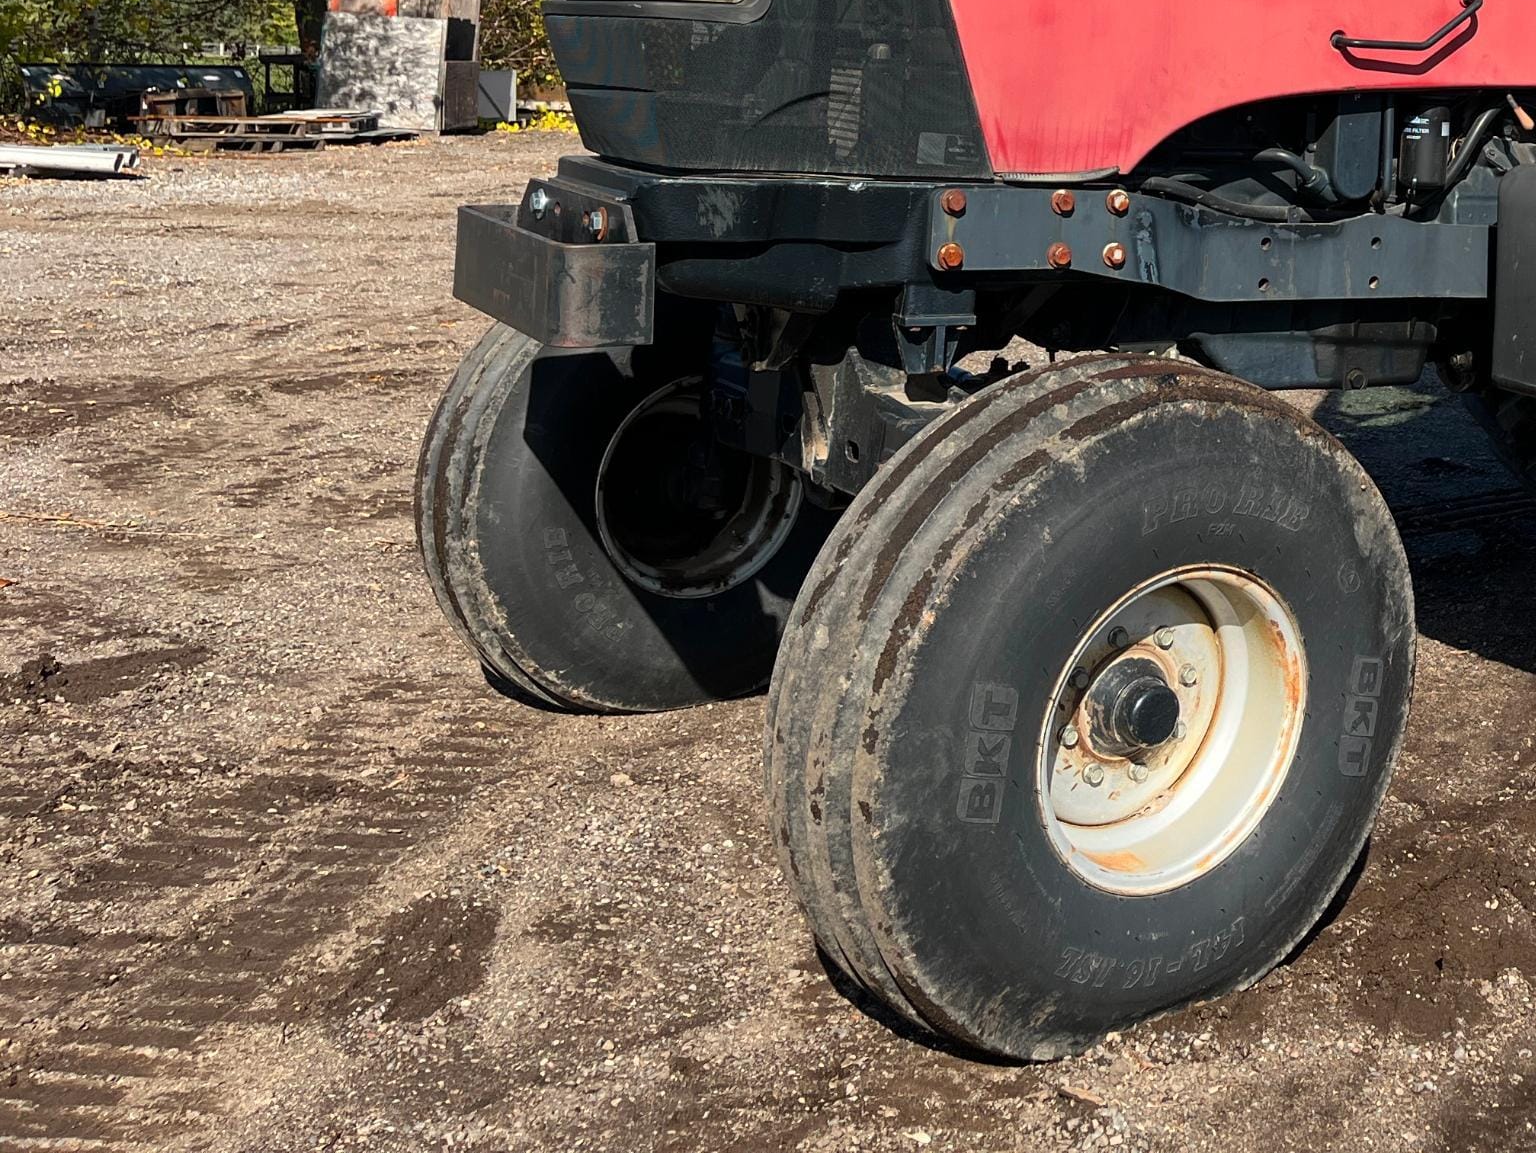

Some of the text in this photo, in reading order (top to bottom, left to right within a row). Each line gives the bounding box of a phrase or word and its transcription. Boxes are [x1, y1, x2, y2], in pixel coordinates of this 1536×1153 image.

[1141, 483, 1311, 536] PRO RIB
[961, 687, 1015, 821] BKT
[1342, 658, 1381, 775] BKT
